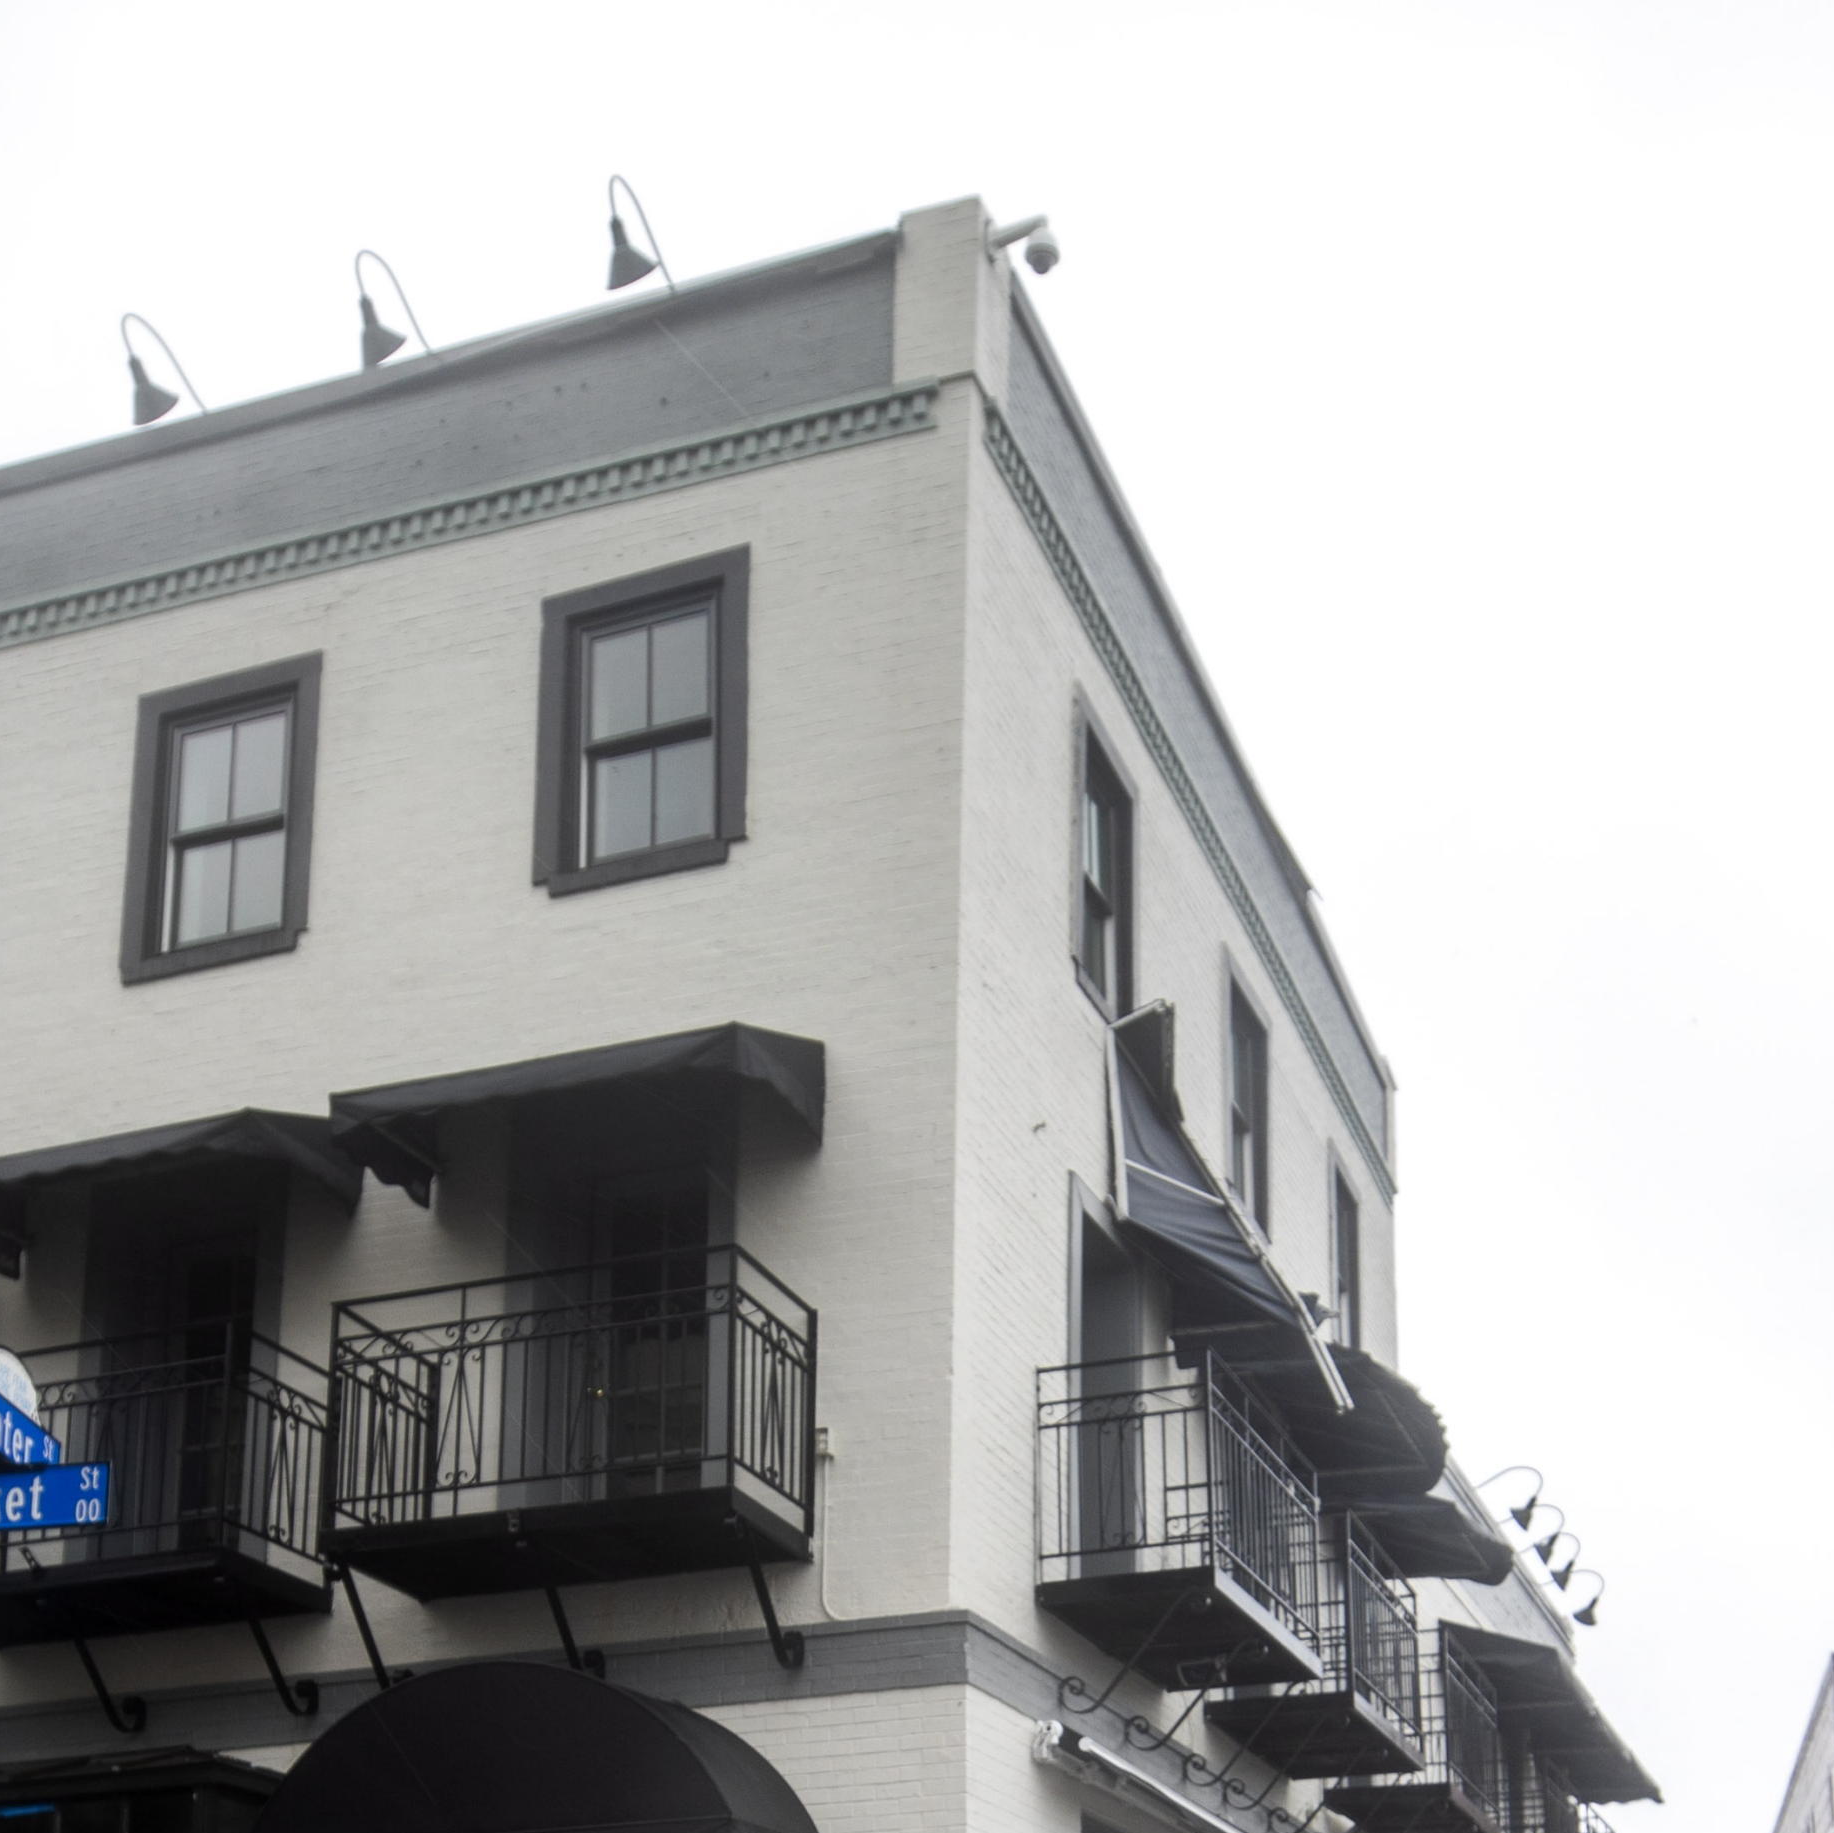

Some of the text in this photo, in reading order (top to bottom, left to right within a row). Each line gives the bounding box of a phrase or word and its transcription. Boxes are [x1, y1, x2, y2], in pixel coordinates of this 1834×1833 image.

[42, 1434, 55, 1463] St
[80, 1467, 99, 1490] St
[75, 1499, 99, 1523] 00
